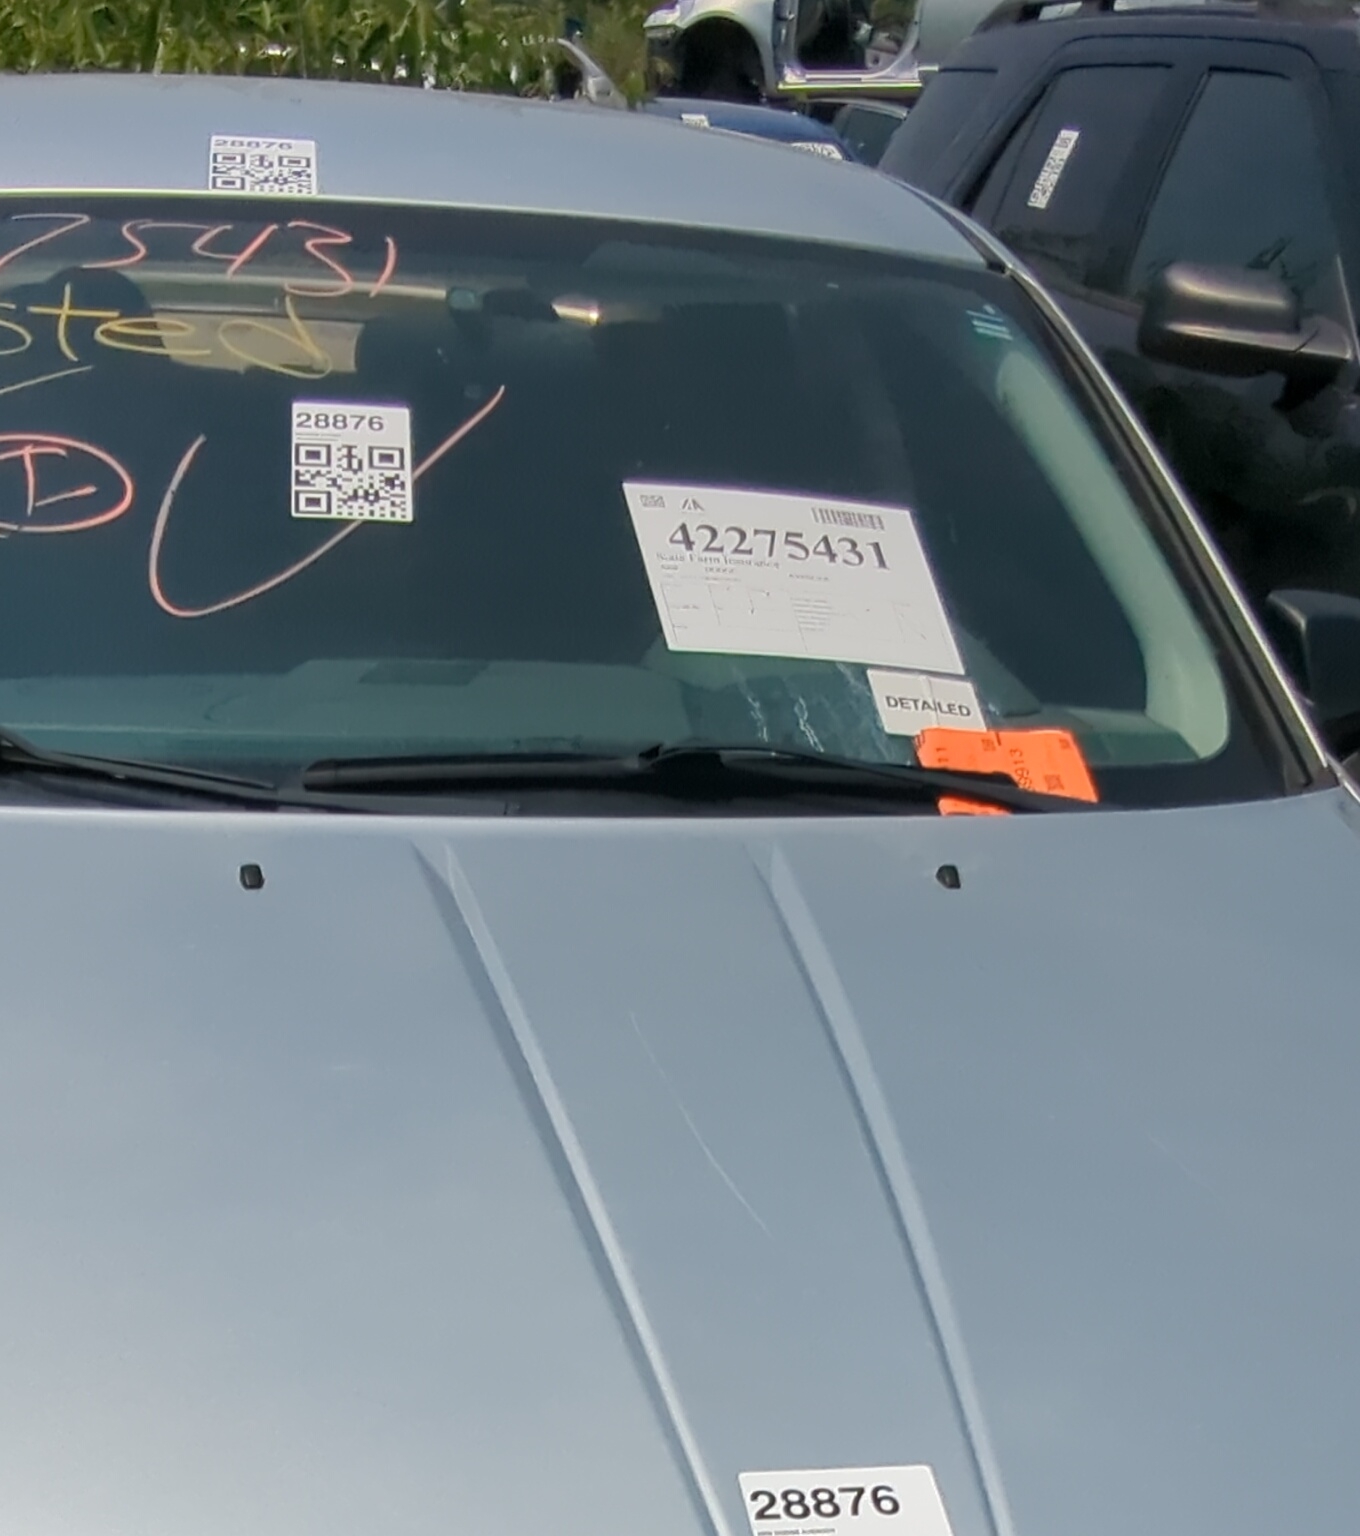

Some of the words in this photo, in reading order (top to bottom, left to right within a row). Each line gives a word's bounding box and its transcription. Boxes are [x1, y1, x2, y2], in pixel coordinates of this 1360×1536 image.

[295, 411, 385, 431] 28876
[668, 521, 891, 571] 42275431
[885, 695, 972, 718] DETAILED
[749, 1485, 901, 1521] 28876
